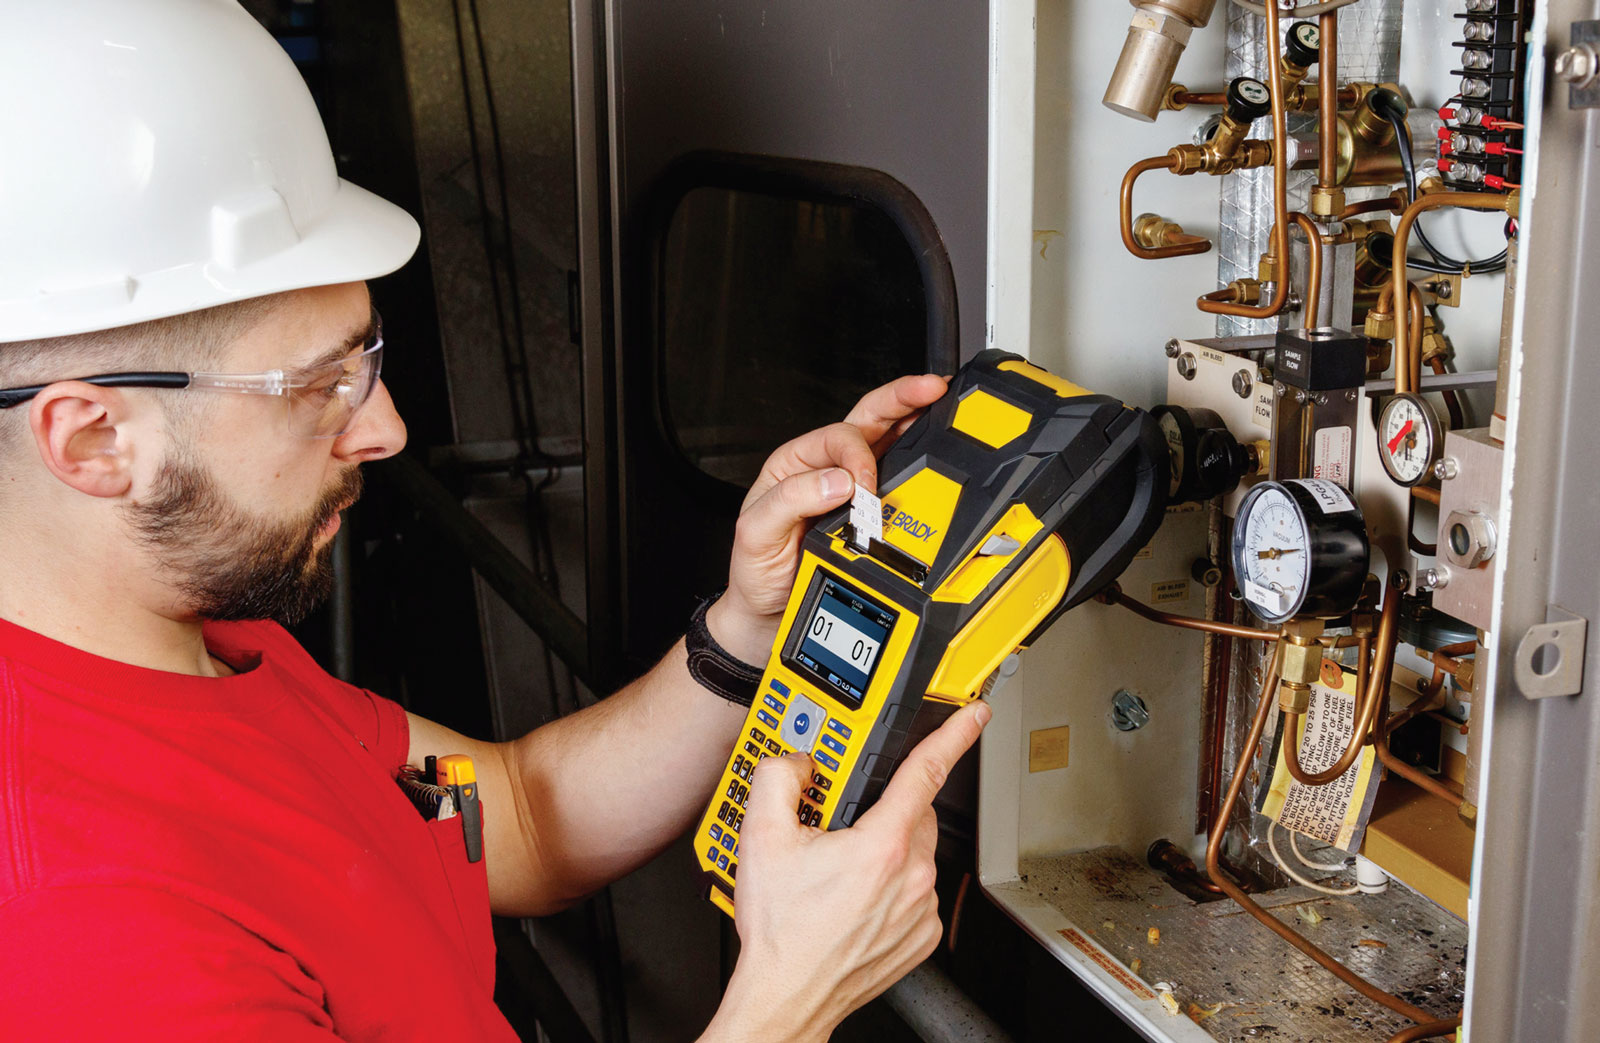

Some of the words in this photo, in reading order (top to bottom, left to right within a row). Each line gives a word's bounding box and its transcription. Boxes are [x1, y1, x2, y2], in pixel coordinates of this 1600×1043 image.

[1284, 350, 1301, 361] SAMPLE
[1286, 360, 1298, 370] FLOW
[892, 511, 938, 542] BRADY
[812, 616, 834, 641] 01
[851, 640, 873, 666] 01
[1308, 709, 1315, 720] 25
[1322, 709, 1330, 720] TO
[1306, 722, 1313, 733] TO
[1321, 721, 1328, 733] UP
[1303, 735, 1310, 747] 20
[1314, 733, 1325, 762] ALLOW
[1300, 815, 1311, 832] FOR
[1321, 730, 1334, 767] PURGING
[1329, 716, 1336, 728] OF
[1307, 825, 1315, 834] IN
[1311, 805, 1322, 822] THE
[1328, 734, 1341, 766] BEFORE
[1314, 815, 1326, 838] FLOW
[1342, 724, 1350, 740] THE
[1327, 790, 1343, 821] FITTING
[1336, 800, 1347, 819] LOW
